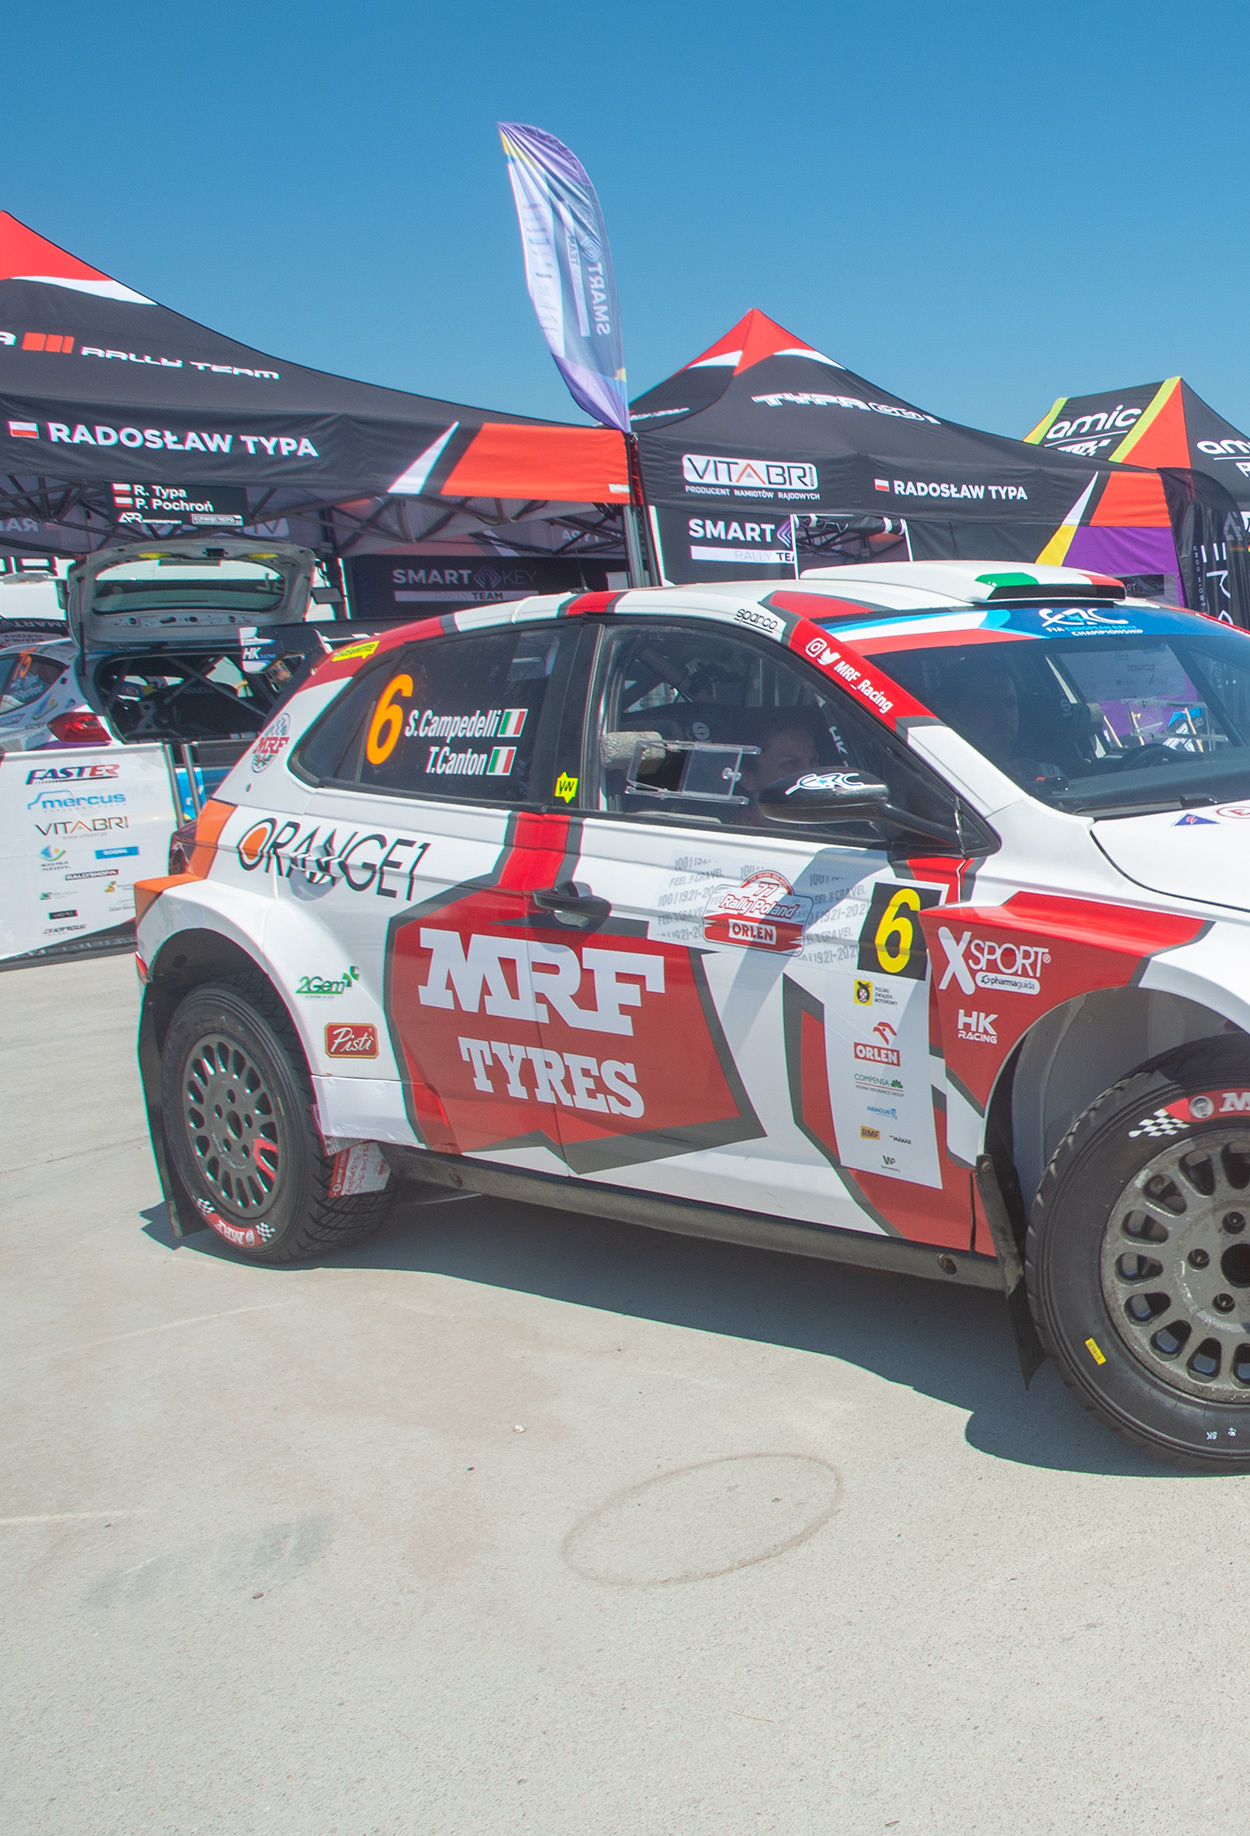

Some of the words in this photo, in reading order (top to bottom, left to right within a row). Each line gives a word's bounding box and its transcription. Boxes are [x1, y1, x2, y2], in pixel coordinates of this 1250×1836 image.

[81, 346, 183, 368] RALLY
[190, 361, 280, 380] TEAM
[1046, 405, 1142, 439] amic
[48, 421, 233, 453] RADOSŁAW
[240, 435, 319, 457] TYPA
[687, 458, 816, 488] VITABRI
[133, 484, 149, 497] R.
[151, 485, 188, 499] Typa
[685, 485, 731, 497] PRODUCENT
[734, 489, 775, 499] NAMIOTÓW
[778, 491, 821, 501] RAJDOWYCH
[893, 480, 982, 499] RADOSŁAW
[987, 485, 1029, 500] TYPA
[134, 497, 149, 510] P.
[152, 499, 214, 513] Pochroń
[688, 519, 776, 543] SMART
[775, 553, 795, 562] TE
[392, 568, 472, 585] SMART
[503, 569, 538, 586] KEY
[472, 591, 504, 601] TEAM
[736, 608, 779, 631] sparco
[1071, 629, 1143, 637] CHAMPIONSHIP
[833, 660, 894, 714] MRF_Racing
[366, 673, 414, 765] 6
[404, 708, 501, 743] S.Campedelli
[252, 736, 290, 754] MRF
[425, 746, 488, 777] T.Canton
[26, 764, 120, 785] FASTER
[42, 793, 127, 810] mercus
[35, 816, 129, 837] VITABRI
[236, 816, 432, 902] ORANGE1
[752, 880, 780, 899] 77
[718, 893, 751, 916] Rally
[749, 898, 800, 920] Poland
[731, 922, 774, 942] ORLEN
[874, 888, 921, 973] 6
[418, 926, 665, 1037] MRF
[990, 976, 1035, 990] pharmaguida
[957, 1008, 998, 1035] HK
[957, 1030, 998, 1045] RACING
[856, 1044, 898, 1064] ORLEN
[457, 1036, 645, 1119] TYRES
[854, 1073, 890, 1087] COMPENSA
[861, 1128, 880, 1139] RMF
[213, 1219, 246, 1246] MRF
